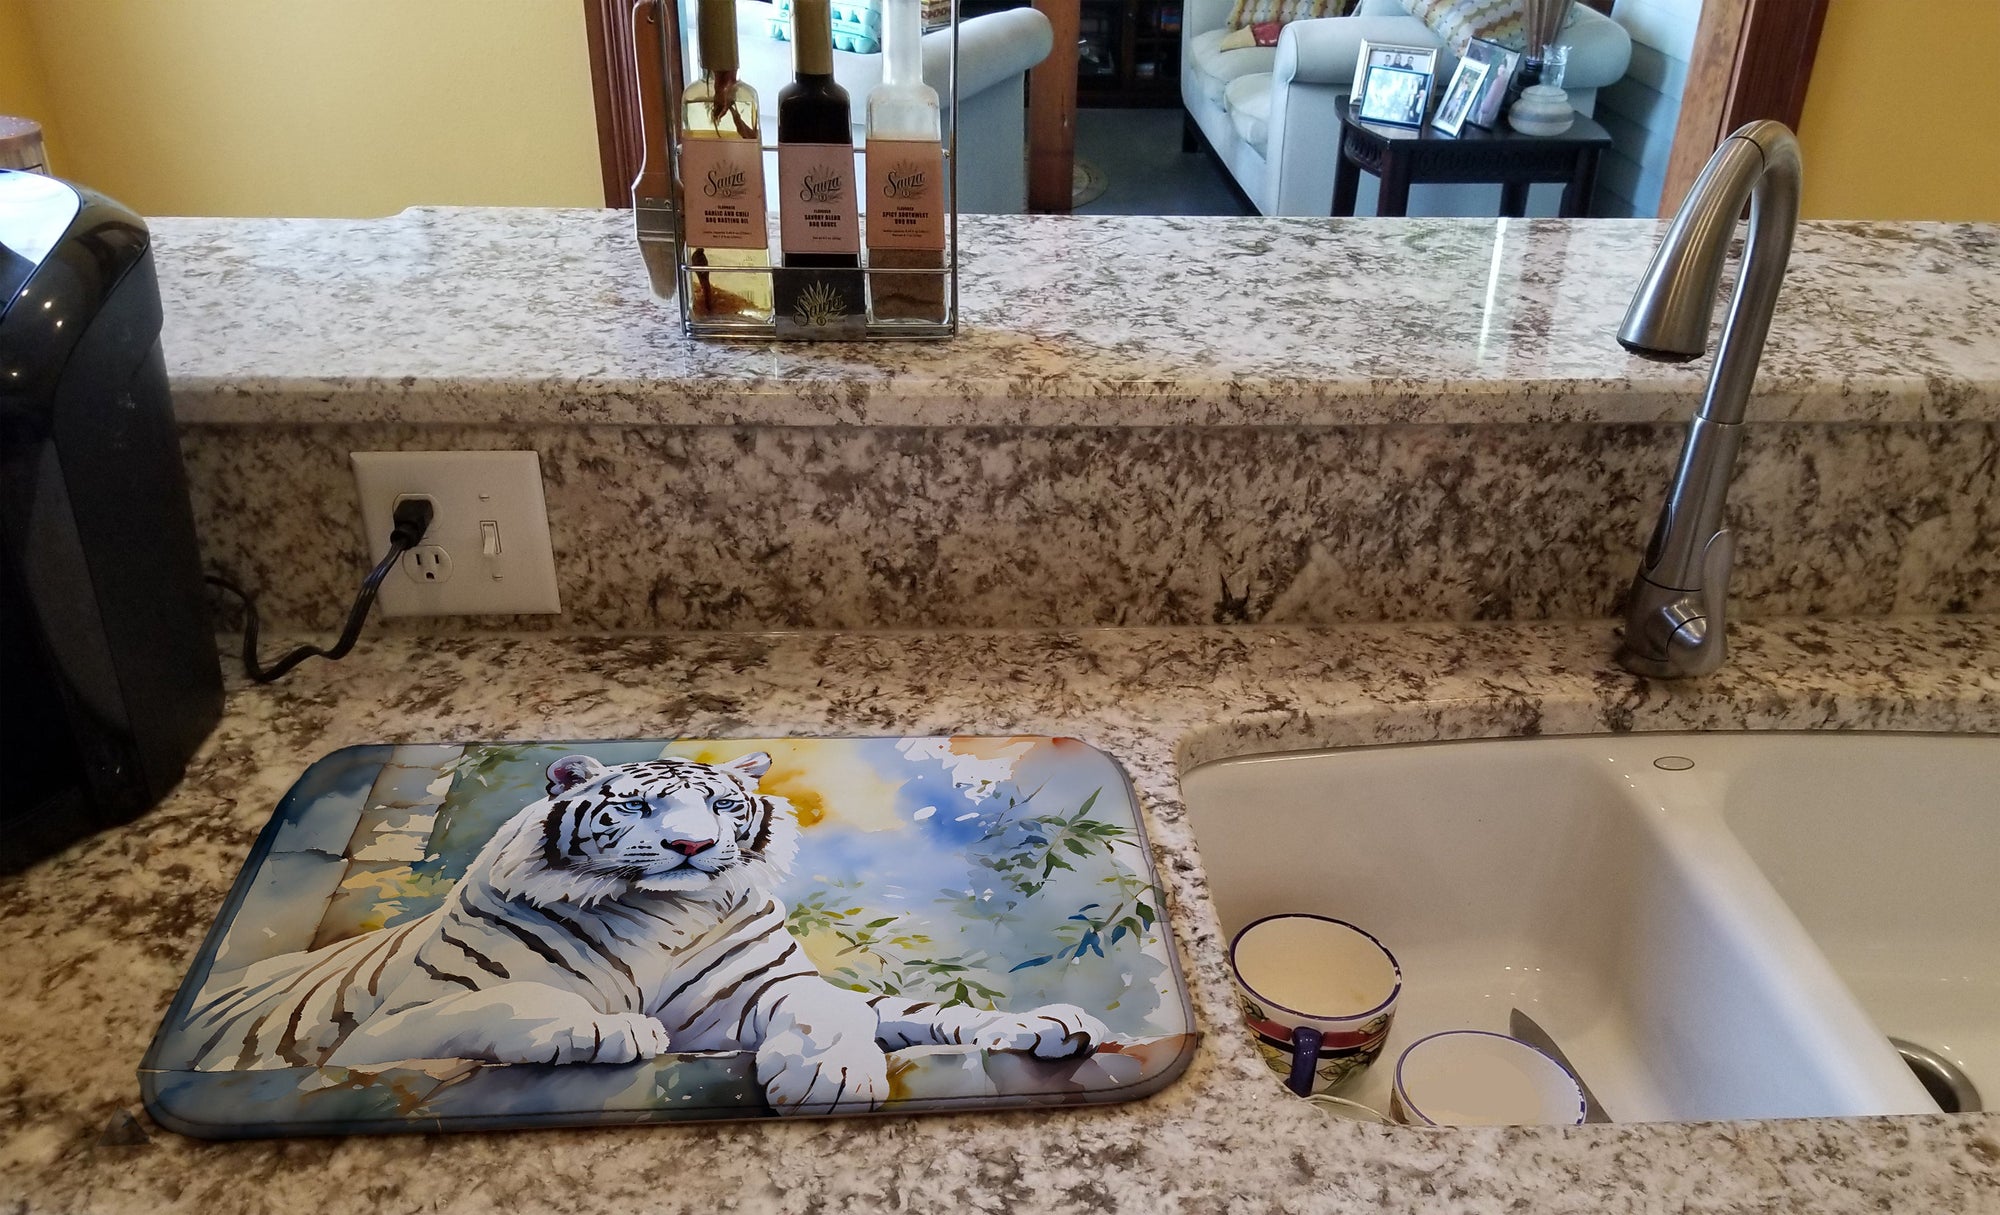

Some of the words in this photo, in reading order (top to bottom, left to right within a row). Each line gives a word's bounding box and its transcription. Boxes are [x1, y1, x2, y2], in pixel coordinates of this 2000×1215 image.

[704, 170, 745, 197] Sauza
[800, 175, 842, 202] Sauza
[884, 171, 925, 198] Sauza
[792, 296, 844, 326] Sauza
